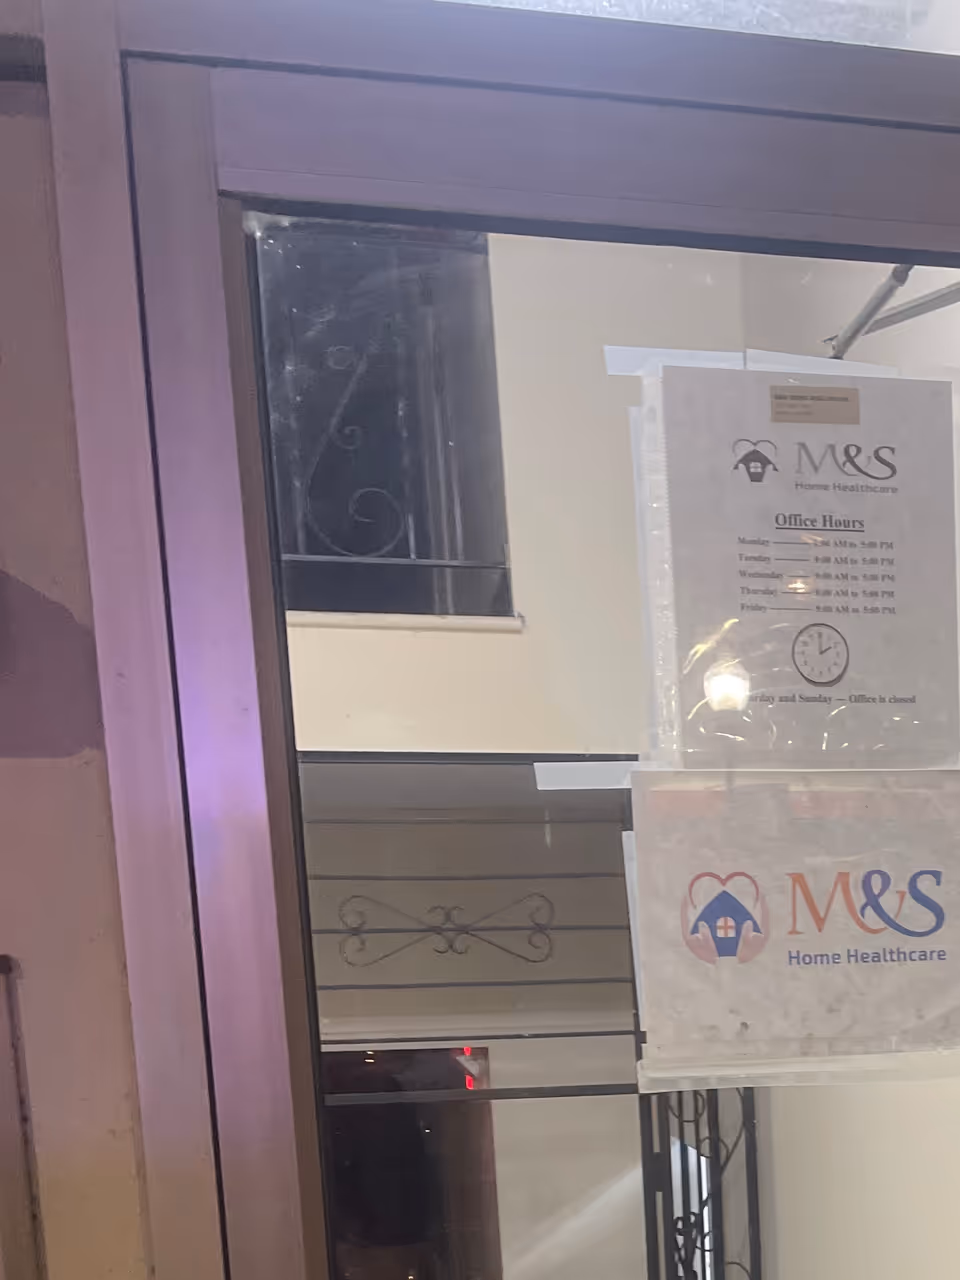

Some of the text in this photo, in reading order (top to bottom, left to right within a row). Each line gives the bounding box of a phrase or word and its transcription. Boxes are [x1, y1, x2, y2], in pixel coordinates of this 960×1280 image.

[792, 441, 898, 480] M&S
[794, 481, 899, 494] Home Healthcare
[775, 513, 866, 529] Office Hours
[737, 536, 770, 547] Monday
[833, 540, 848, 548] AM
[880, 541, 894, 550] PM
[738, 553, 771, 564] Tuesday
[834, 556, 848, 565] AM
[880, 557, 895, 566] PM
[834, 573, 849, 581] AM
[881, 574, 895, 582] PM
[739, 586, 777, 597] Thursday
[834, 589, 849, 597] AM
[881, 590, 895, 598] PM
[740, 603, 767, 614] Friday
[835, 605, 849, 613] AM
[882, 606, 896, 615] PM
[778, 693, 796, 704] and
[798, 694, 833, 705] Sunday
[849, 694, 877, 704] Office
[888, 694, 917, 704] closed
[784, 868, 946, 938] M&S
[787, 946, 948, 966] Home Healthcare
